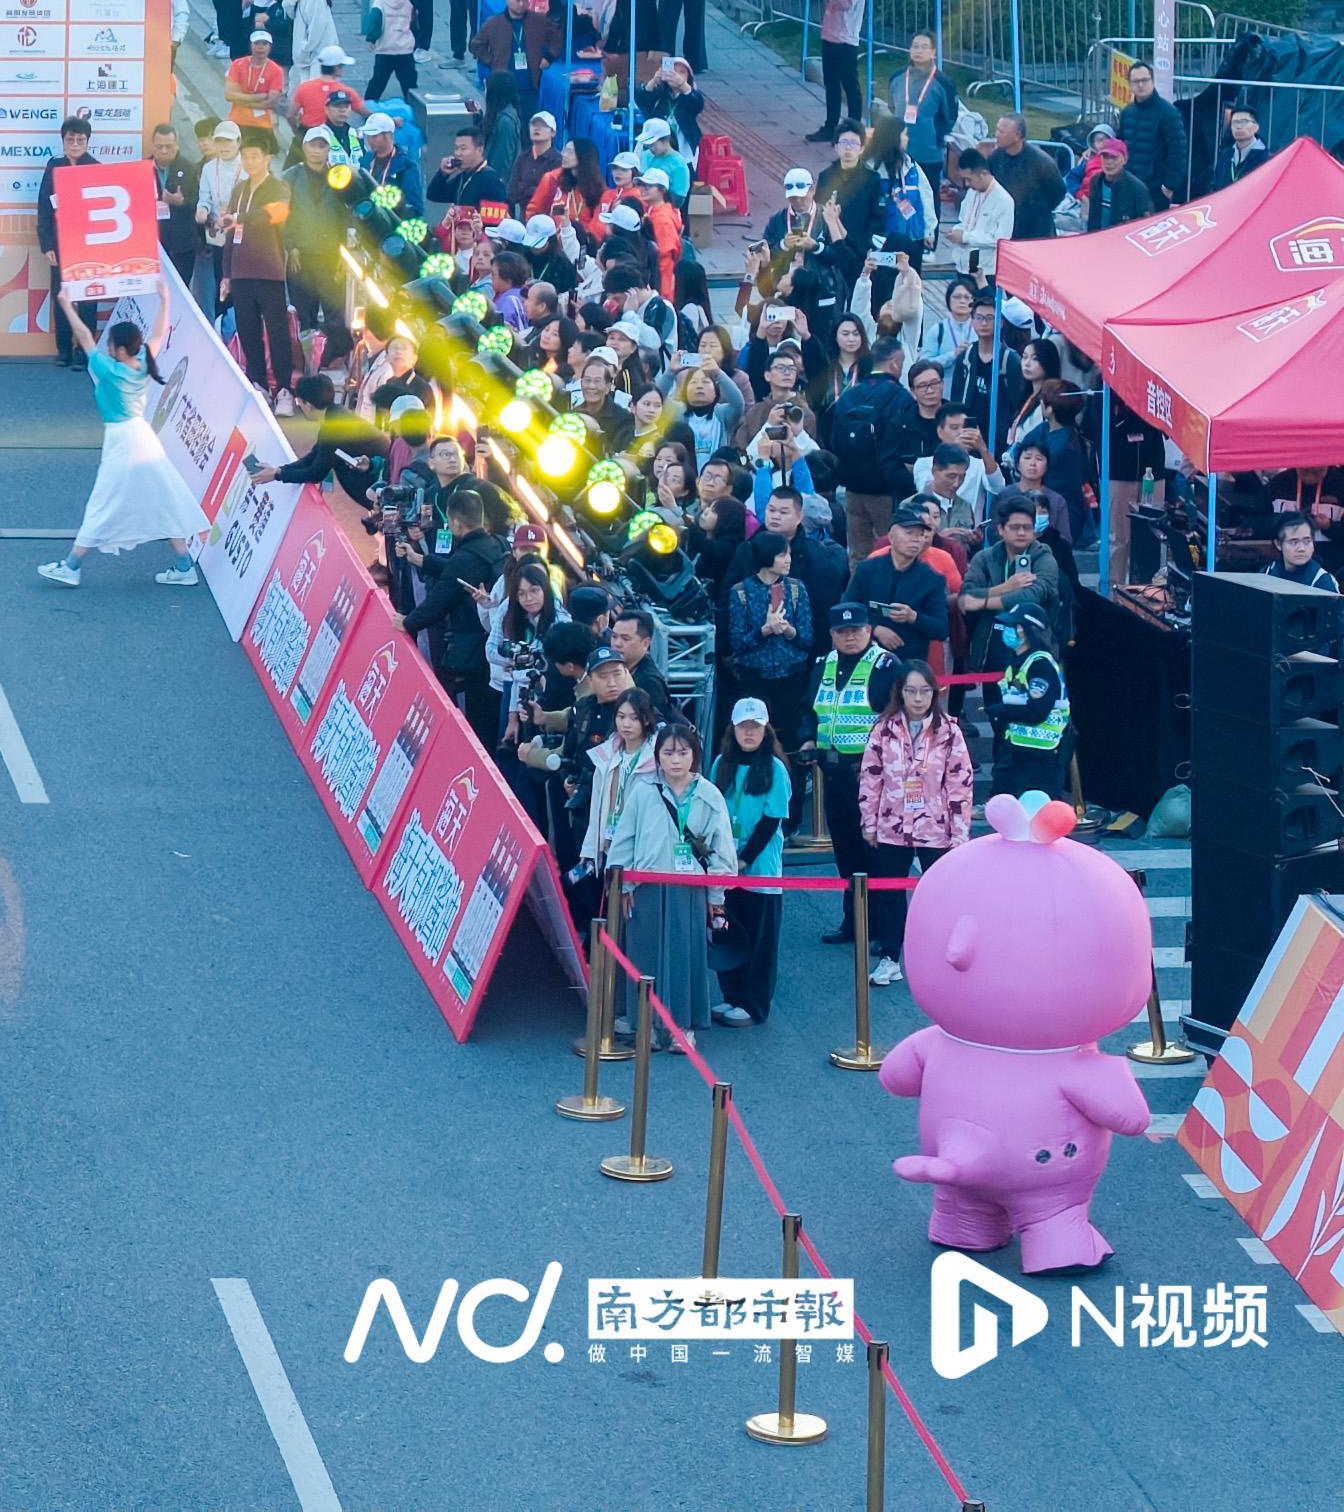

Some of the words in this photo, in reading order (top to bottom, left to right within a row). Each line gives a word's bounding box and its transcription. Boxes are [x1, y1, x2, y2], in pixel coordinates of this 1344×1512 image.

[9, 108, 58, 120] WENGE
[1, 145, 53, 157] MEXDA
[81, 185, 133, 246] 3
[224, 518, 254, 579] GUSTO
[291, 550, 317, 602] 海天
[358, 660, 387, 719] 海天
[435, 788, 467, 852] 海天
